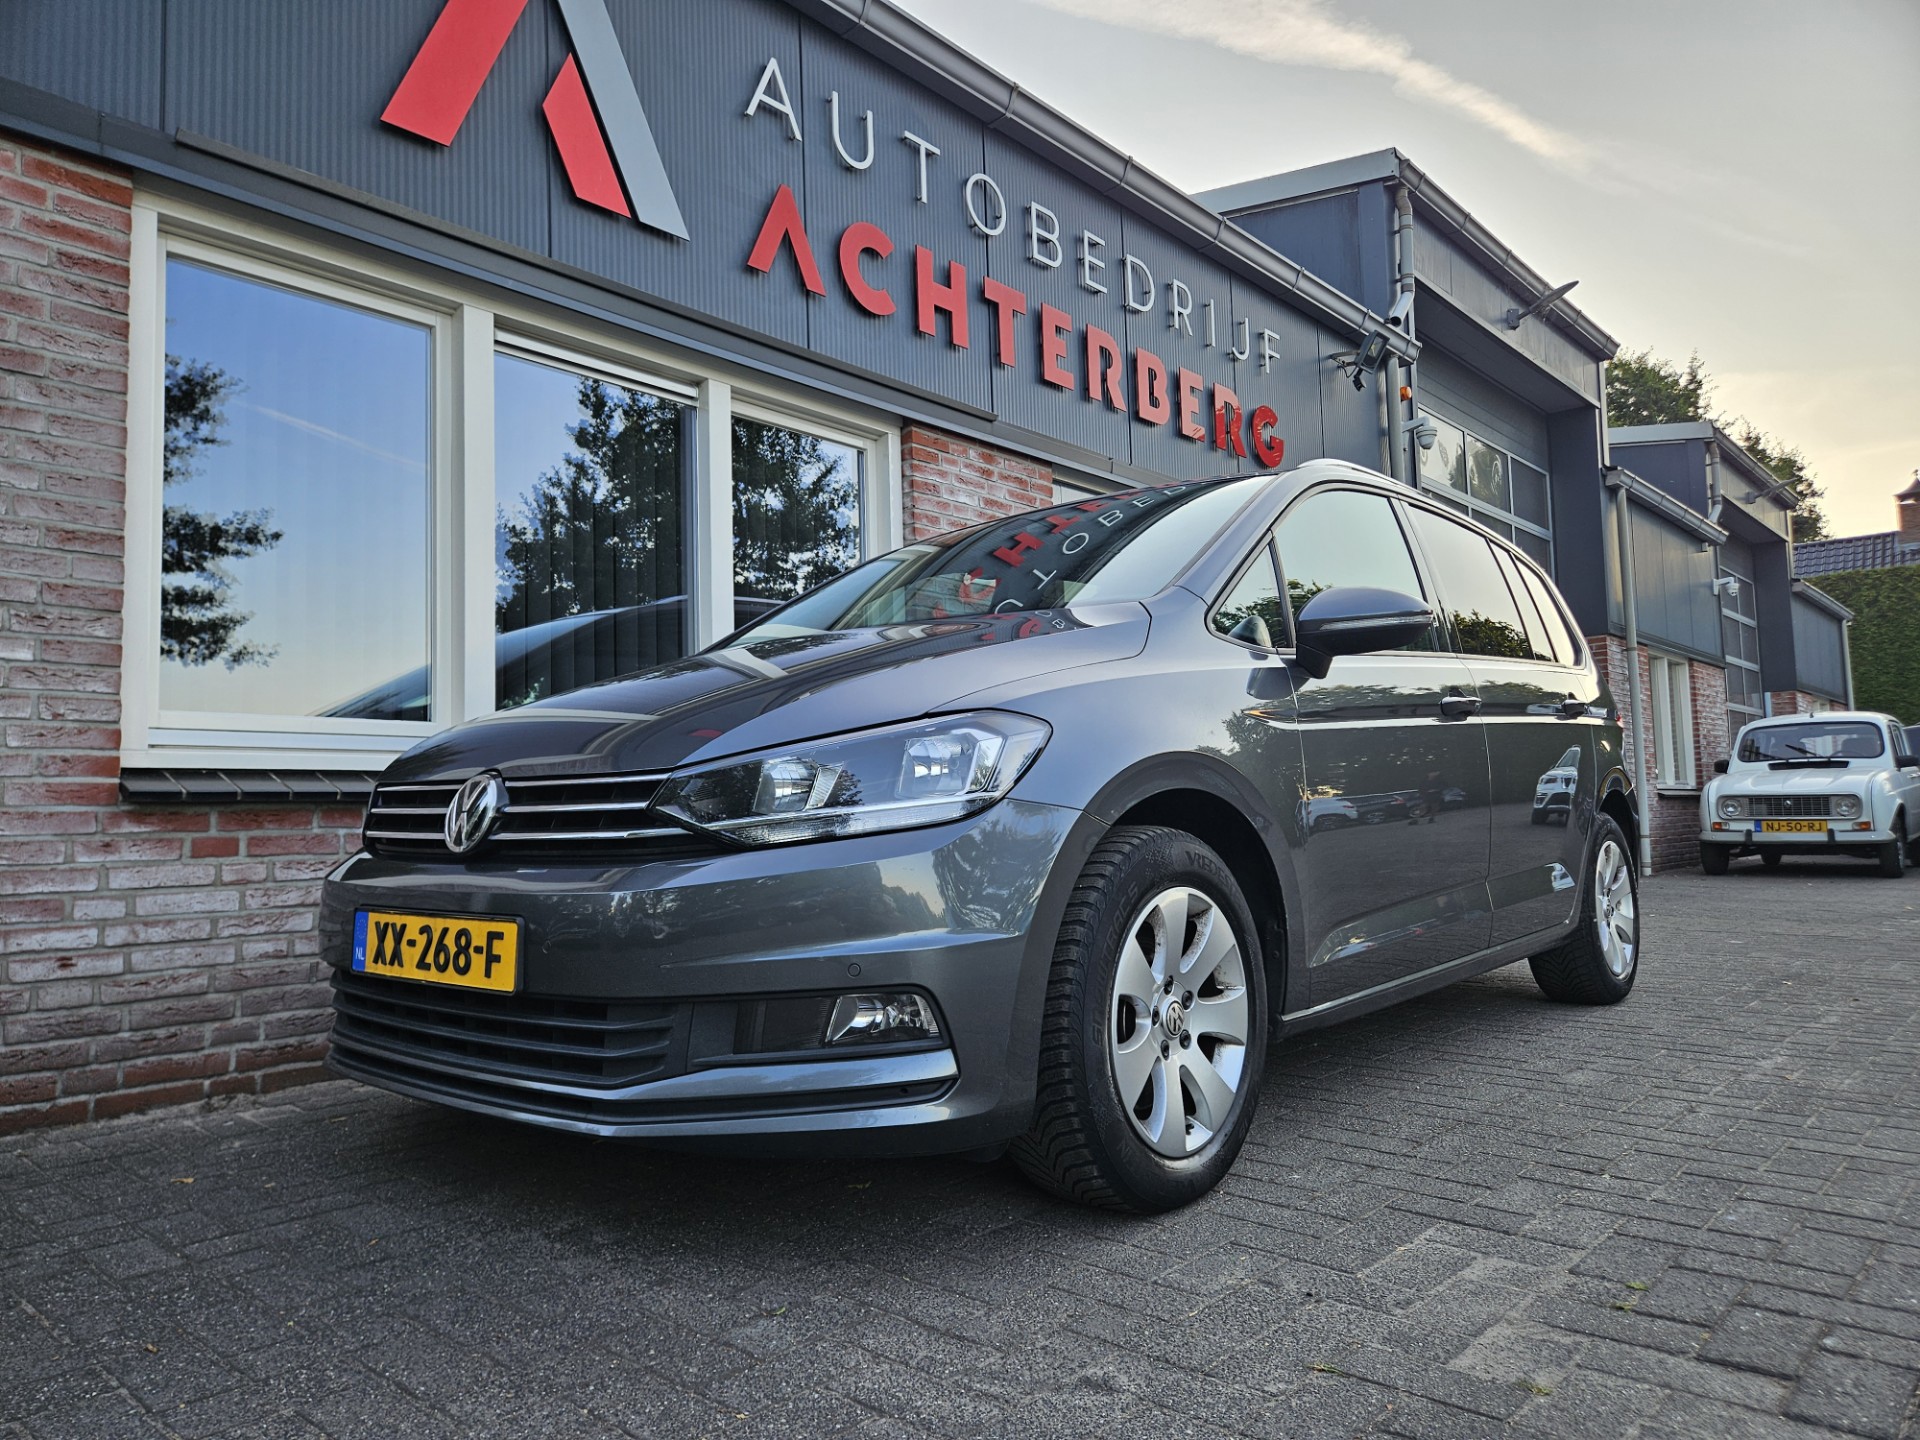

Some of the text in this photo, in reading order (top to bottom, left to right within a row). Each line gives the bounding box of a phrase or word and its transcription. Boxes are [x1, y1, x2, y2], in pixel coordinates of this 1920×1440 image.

[744, 56, 1282, 374] AUTOBEDRIJF
[747, 183, 1286, 468] ACHTERBERG
[1765, 822, 1822, 832] NJ-50-RJ
[355, 947, 365, 960] NL
[372, 920, 504, 979] XX-268-F
